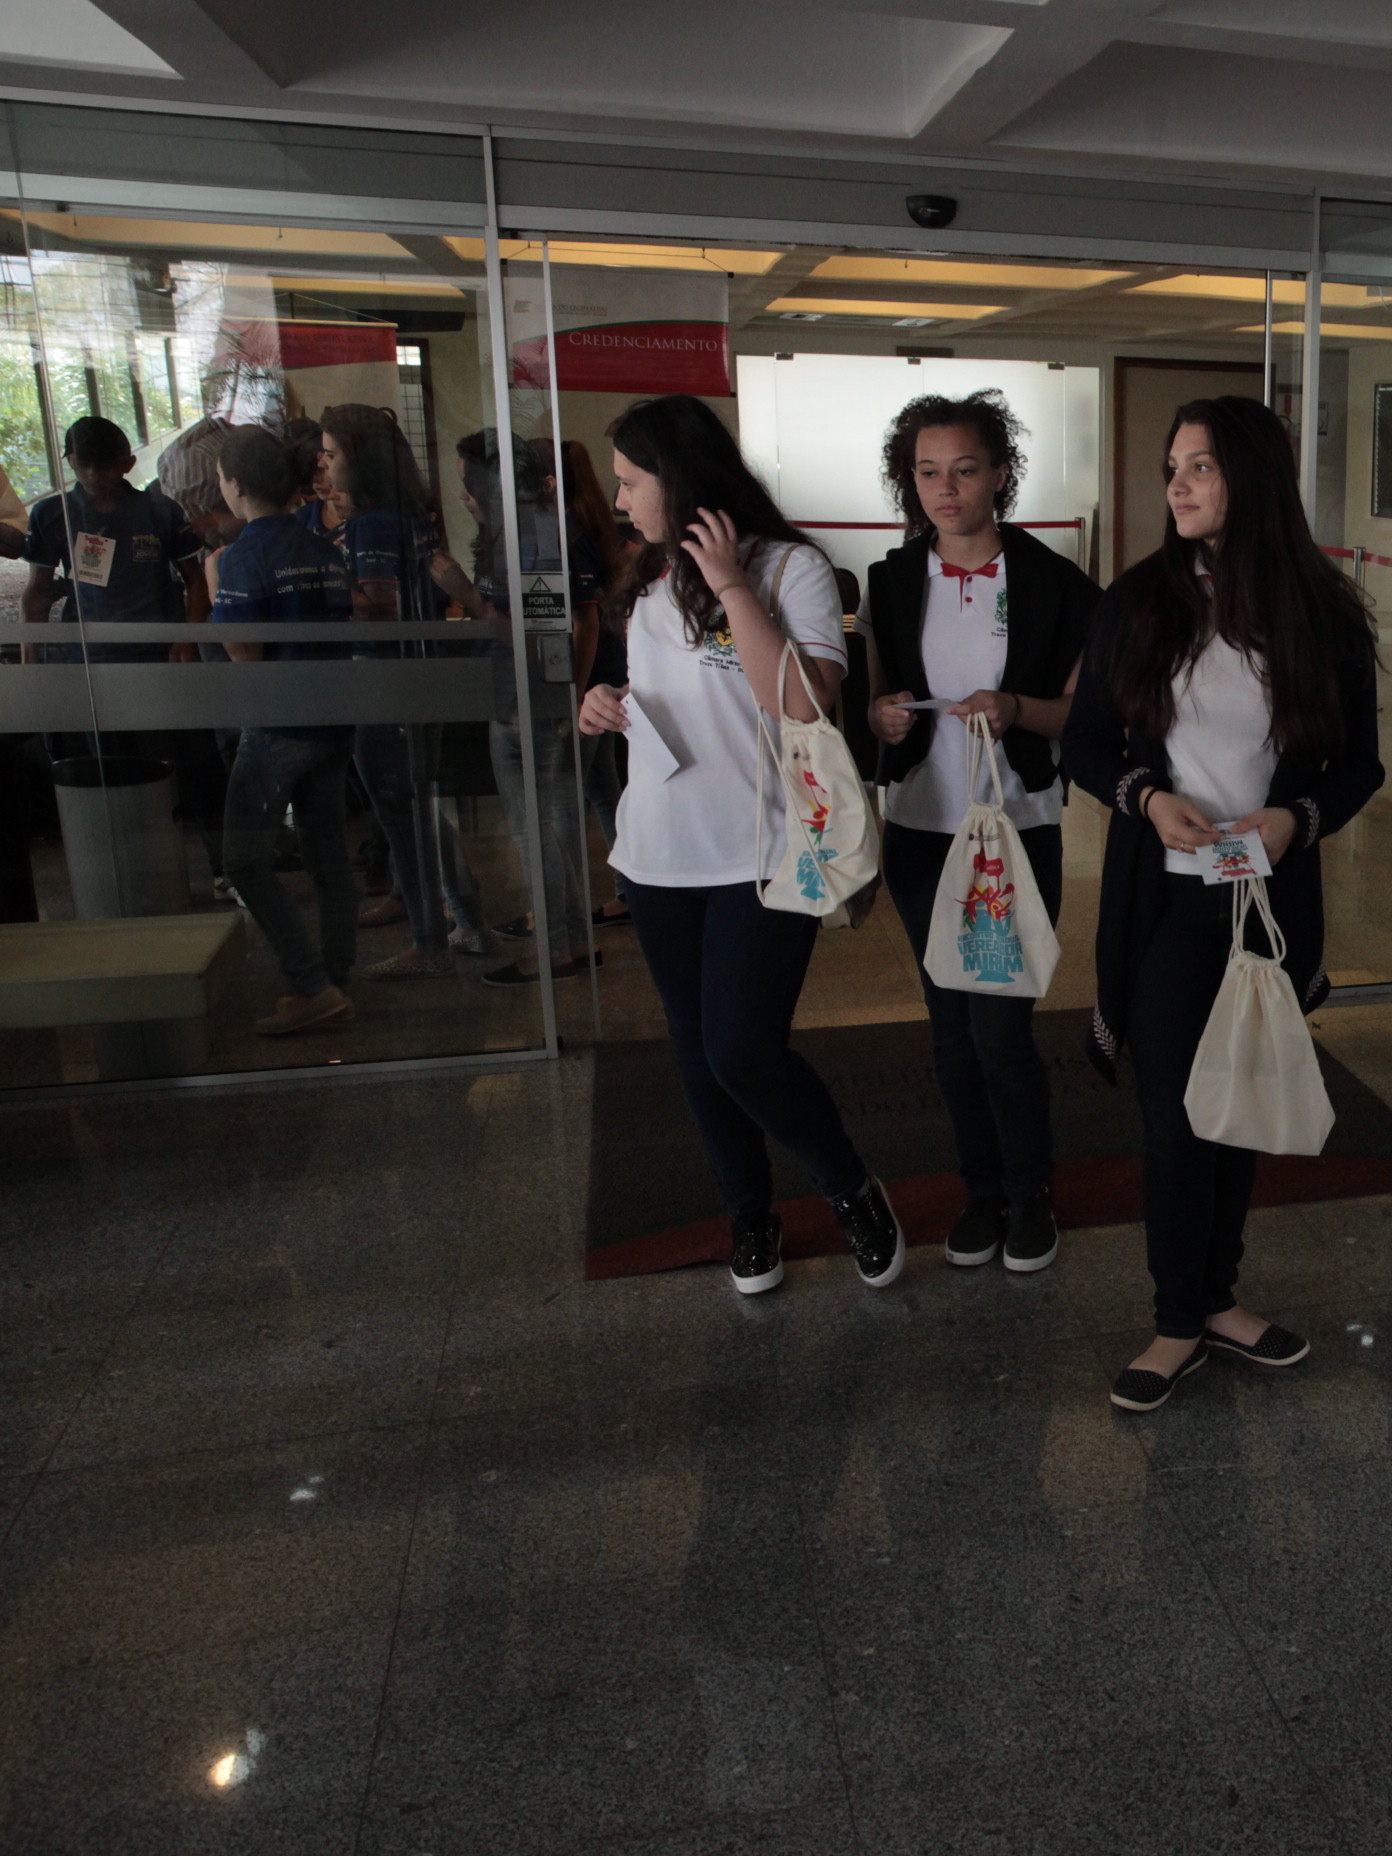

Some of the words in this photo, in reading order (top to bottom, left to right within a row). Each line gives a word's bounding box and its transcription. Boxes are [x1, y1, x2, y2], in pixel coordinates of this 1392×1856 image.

[569, 332, 718, 352] CREDENCIAMENTO
[528, 596, 555, 605] PORTA
[523, 605, 567, 616] UTOMÁTICA
[704, 655, 724, 663] Câmara
[957, 939, 1023, 957] VEREADOR
[963, 953, 1024, 972] MIRIM
